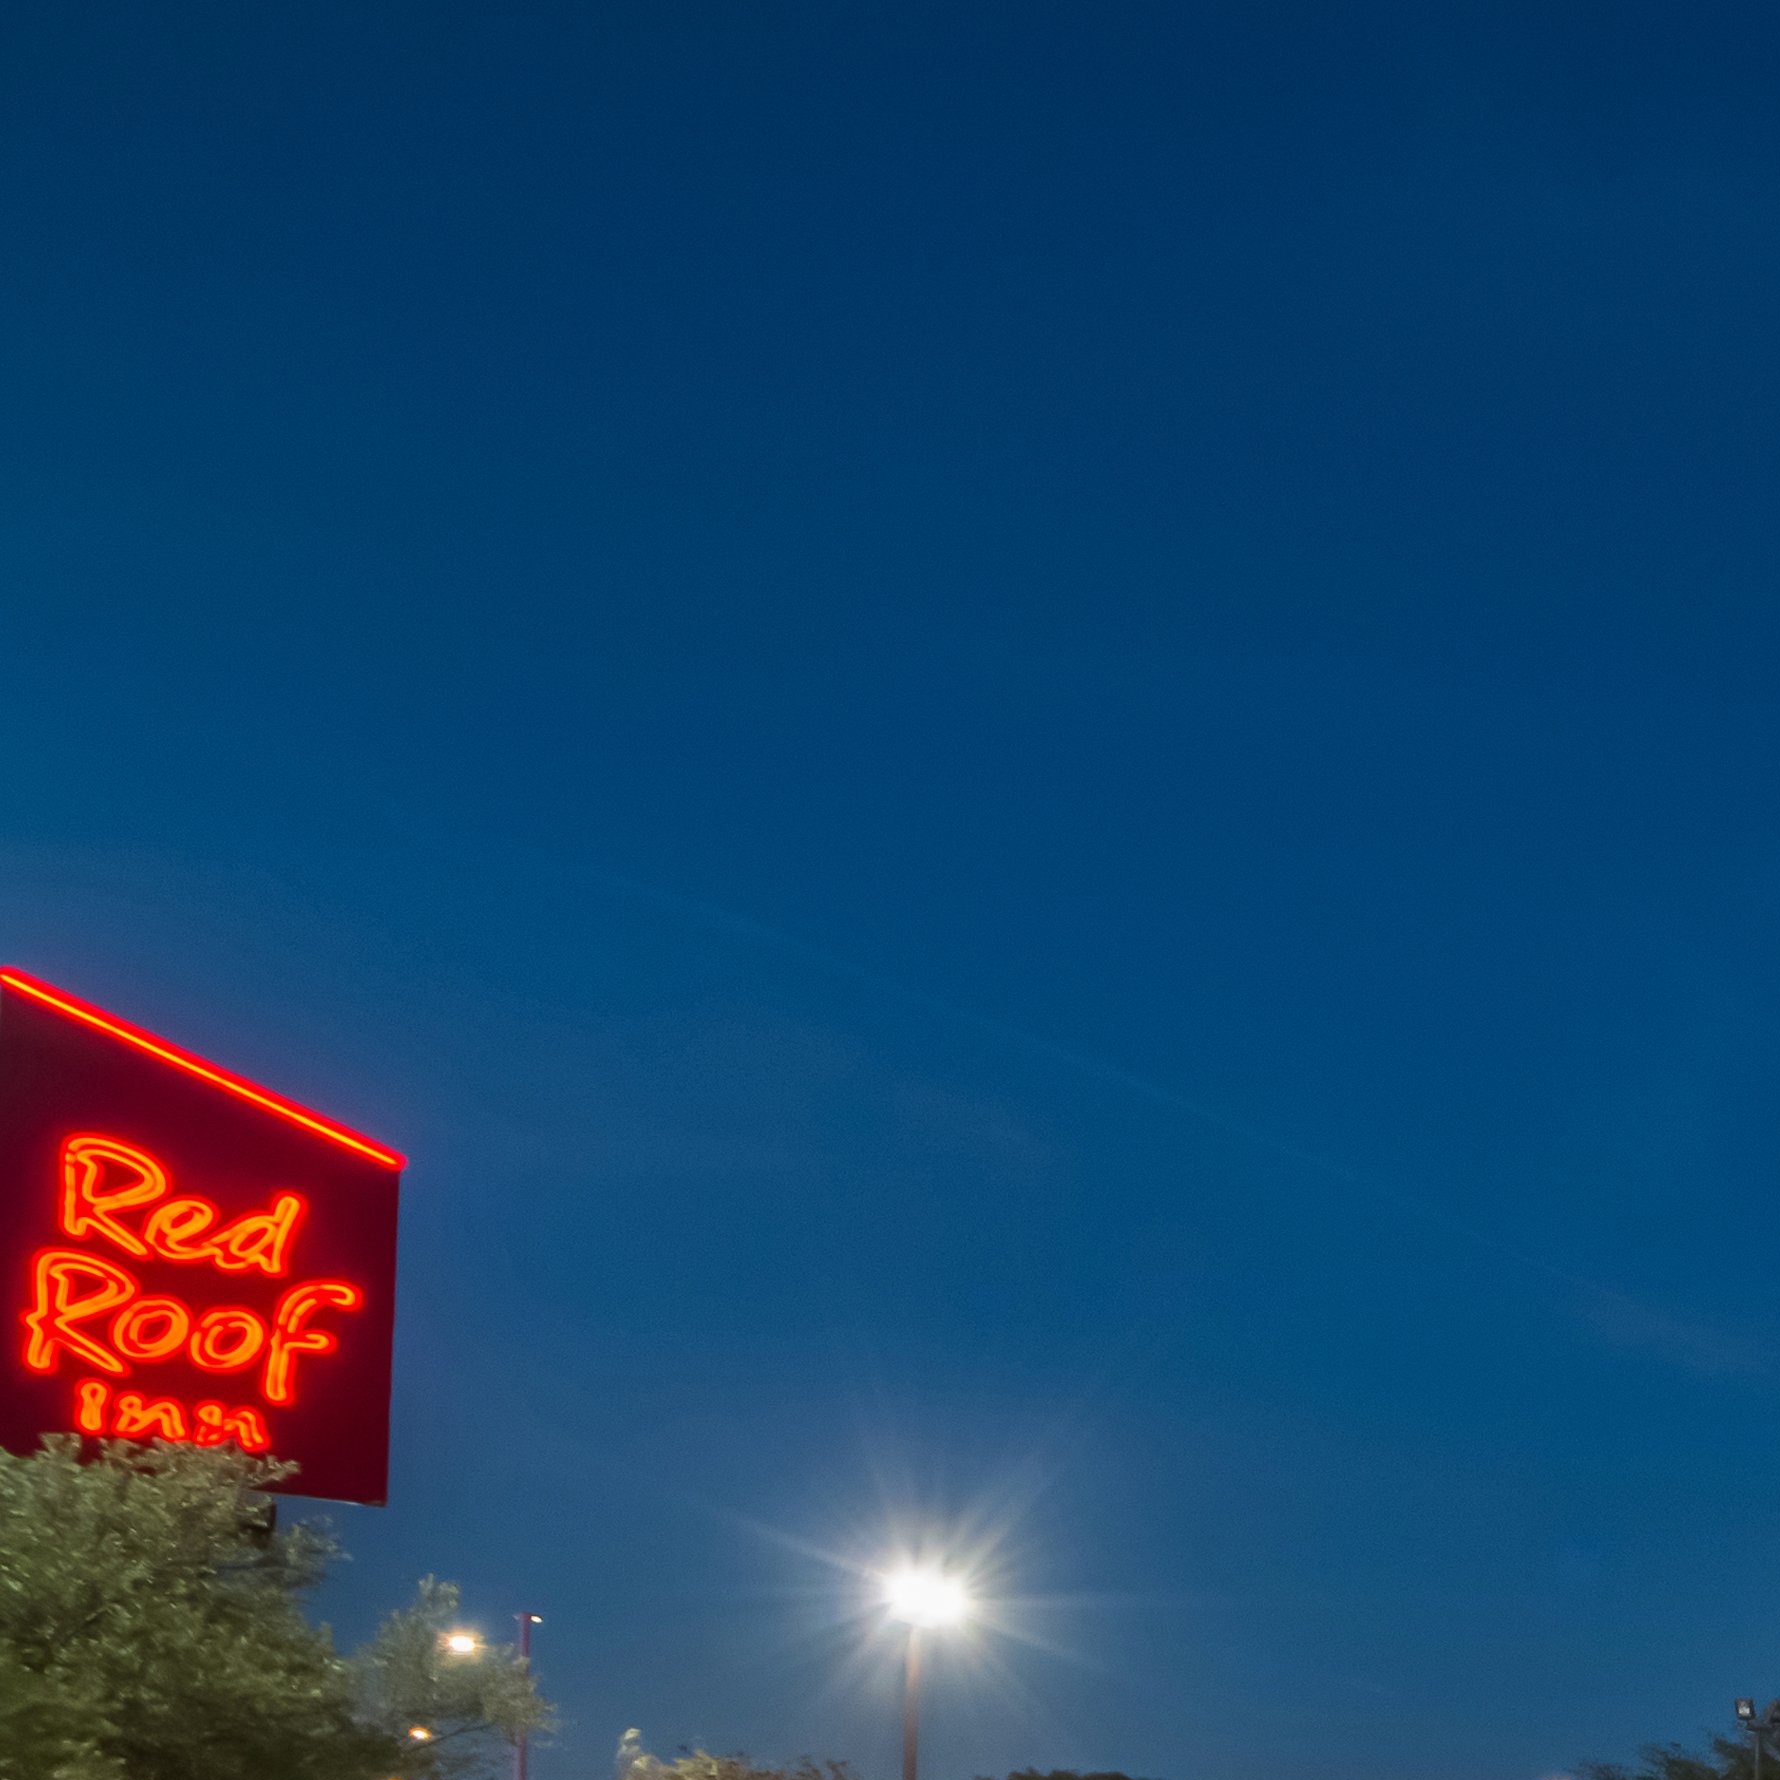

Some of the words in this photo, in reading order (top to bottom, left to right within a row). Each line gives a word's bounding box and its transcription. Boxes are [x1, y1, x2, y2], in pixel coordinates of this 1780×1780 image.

[60, 1134, 304, 1275] Red
[24, 1250, 361, 1403] Roof
[77, 1380, 268, 1450] Inn
